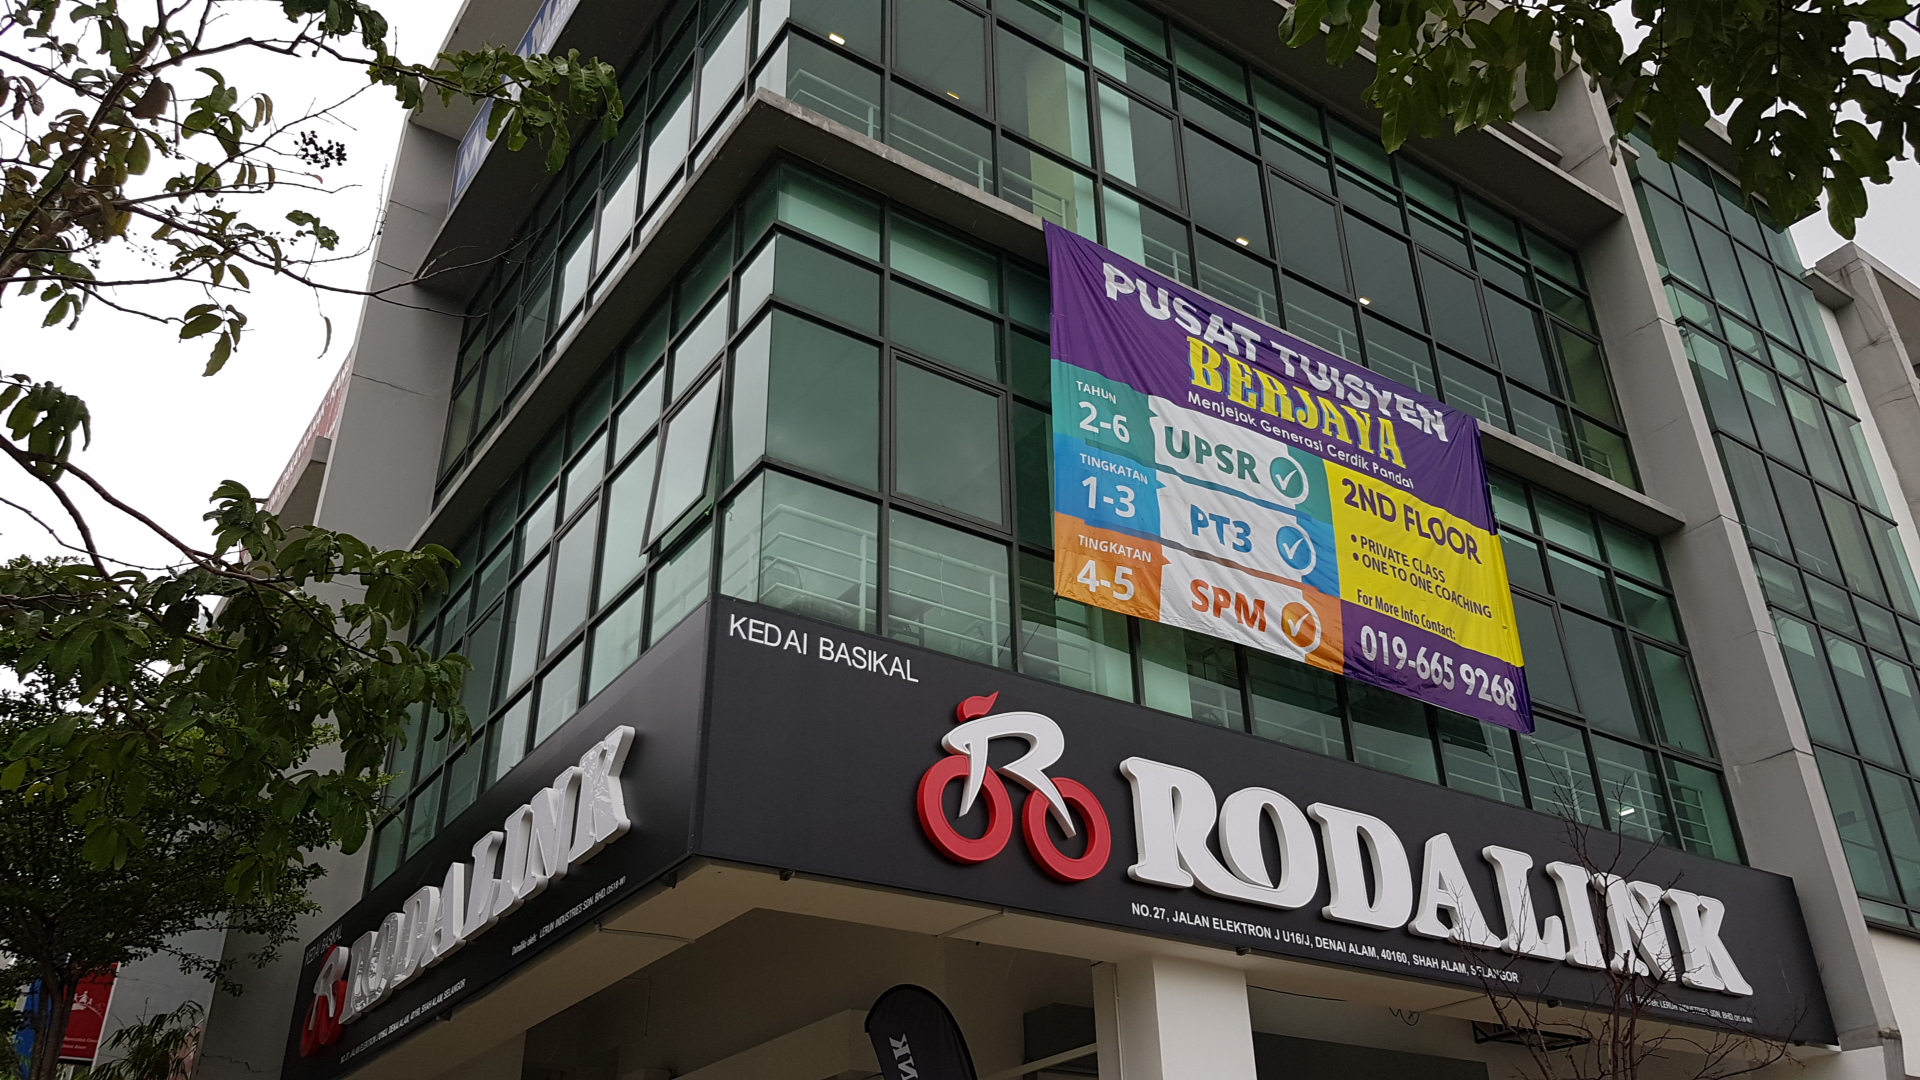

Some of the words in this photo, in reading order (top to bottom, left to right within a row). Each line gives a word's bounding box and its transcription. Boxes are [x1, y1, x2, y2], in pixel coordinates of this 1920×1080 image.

[1103, 262, 1261, 361] PUSAT
[1272, 336, 1448, 442] TUISYEN
[1076, 380, 1117, 403] TAHUN
[1186, 335, 1407, 469] BERJAYA
[1078, 400, 1130, 444] 2-6
[1188, 391, 1257, 428] Menjejak
[1259, 419, 1323, 453] Generasi
[1327, 443, 1369, 473] Cerdik
[1372, 461, 1414, 490] Pandai
[1079, 453, 1149, 485] TINGKATAN
[1164, 425, 1261, 484] UPSR
[1082, 476, 1136, 518] 1-3
[1341, 478, 1398, 524] 2ND
[1403, 504, 1483, 565] FLOOR
[1078, 534, 1152, 563] TINGKATAN
[1190, 504, 1253, 553] PT3
[1076, 559, 1135, 601] 4-5
[1361, 535, 1410, 567] PRIVATE
[1412, 557, 1446, 583] CLASS
[1362, 553, 1389, 576] ONE
[1389, 564, 1407, 582] TO
[1409, 574, 1434, 595] ONE
[1435, 584, 1493, 619] COACHING
[1190, 578, 1267, 633] SPM
[1357, 589, 1373, 607] For
[1375, 595, 1399, 617] More
[1401, 605, 1420, 625] Info
[1421, 614, 1456, 640] Contact:
[729, 613, 808, 655] KEDAI
[818, 636, 920, 683] BASIKAL
[1360, 625, 1455, 691] 019-665
[1459, 663, 1518, 712] 9268
[338, 725, 635, 1025] RODALINK
[1119, 755, 1753, 997] RODALINK
[555, 903, 584, 929] INDUSTRIES
[1172, 910, 1210, 928] JALAN
[1212, 917, 1272, 940] ELEKTRON
[1274, 929, 1280, 941] J
[1282, 930, 1314, 949] U16/J,
[1315, 936, 1347, 953] DENAI
[1348, 943, 1380, 960] ALAM,
[1381, 948, 1411, 966] 40160,
[1412, 954, 1439, 970] SHAH
[1441, 959, 1470, 976] ALAM,
